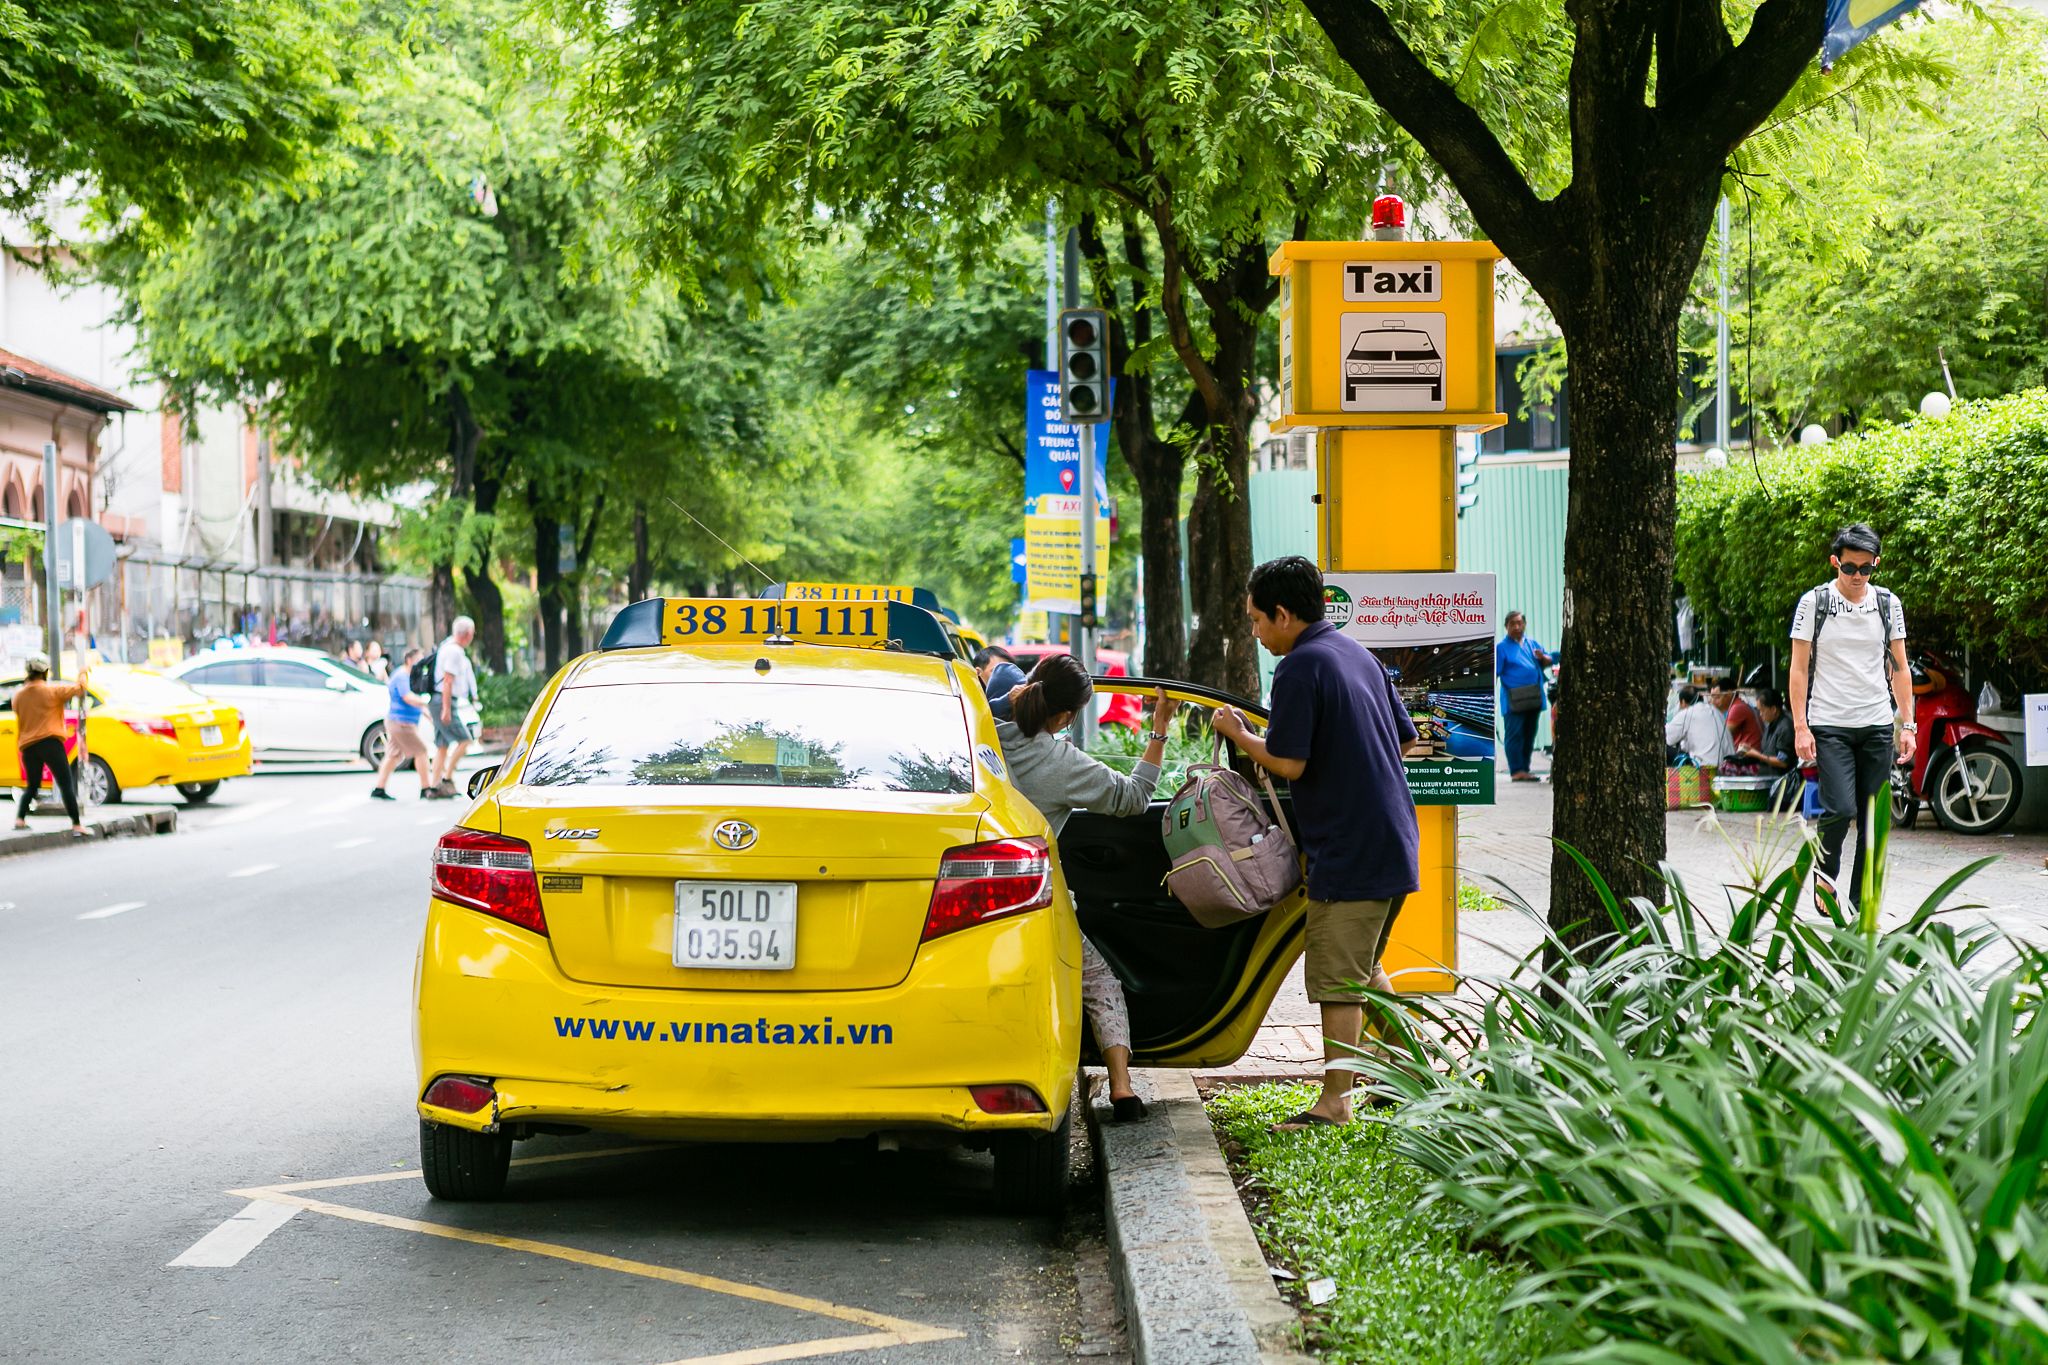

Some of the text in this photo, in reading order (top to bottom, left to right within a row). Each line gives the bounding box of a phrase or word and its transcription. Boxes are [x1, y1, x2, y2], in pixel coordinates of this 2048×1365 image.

[1347, 265, 1433, 293] Taxi
[1046, 384, 1061, 393] TH
[1046, 424, 1069, 434] KHU
[1038, 436, 1075, 447] TRUNG
[795, 586, 822, 599] 38
[831, 588, 861, 600] 111
[1359, 595, 1381, 607] Siêu
[1397, 596, 1419, 610] hàng
[1421, 593, 1451, 609] nhập
[1453, 590, 1484, 607] khẩu
[1324, 604, 1348, 613] ON
[1357, 614, 1379, 624] cao
[1381, 606, 1402, 628] cấp
[1419, 609, 1448, 627] Việt
[1450, 609, 1486, 624] Nam
[674, 605, 878, 636] 38 111 111
[544, 828, 602, 840] VIOS
[702, 889, 771, 922] 50LD
[688, 928, 780, 961] 035.94
[553, 1016, 894, 1046] www.vinataxi.vn
